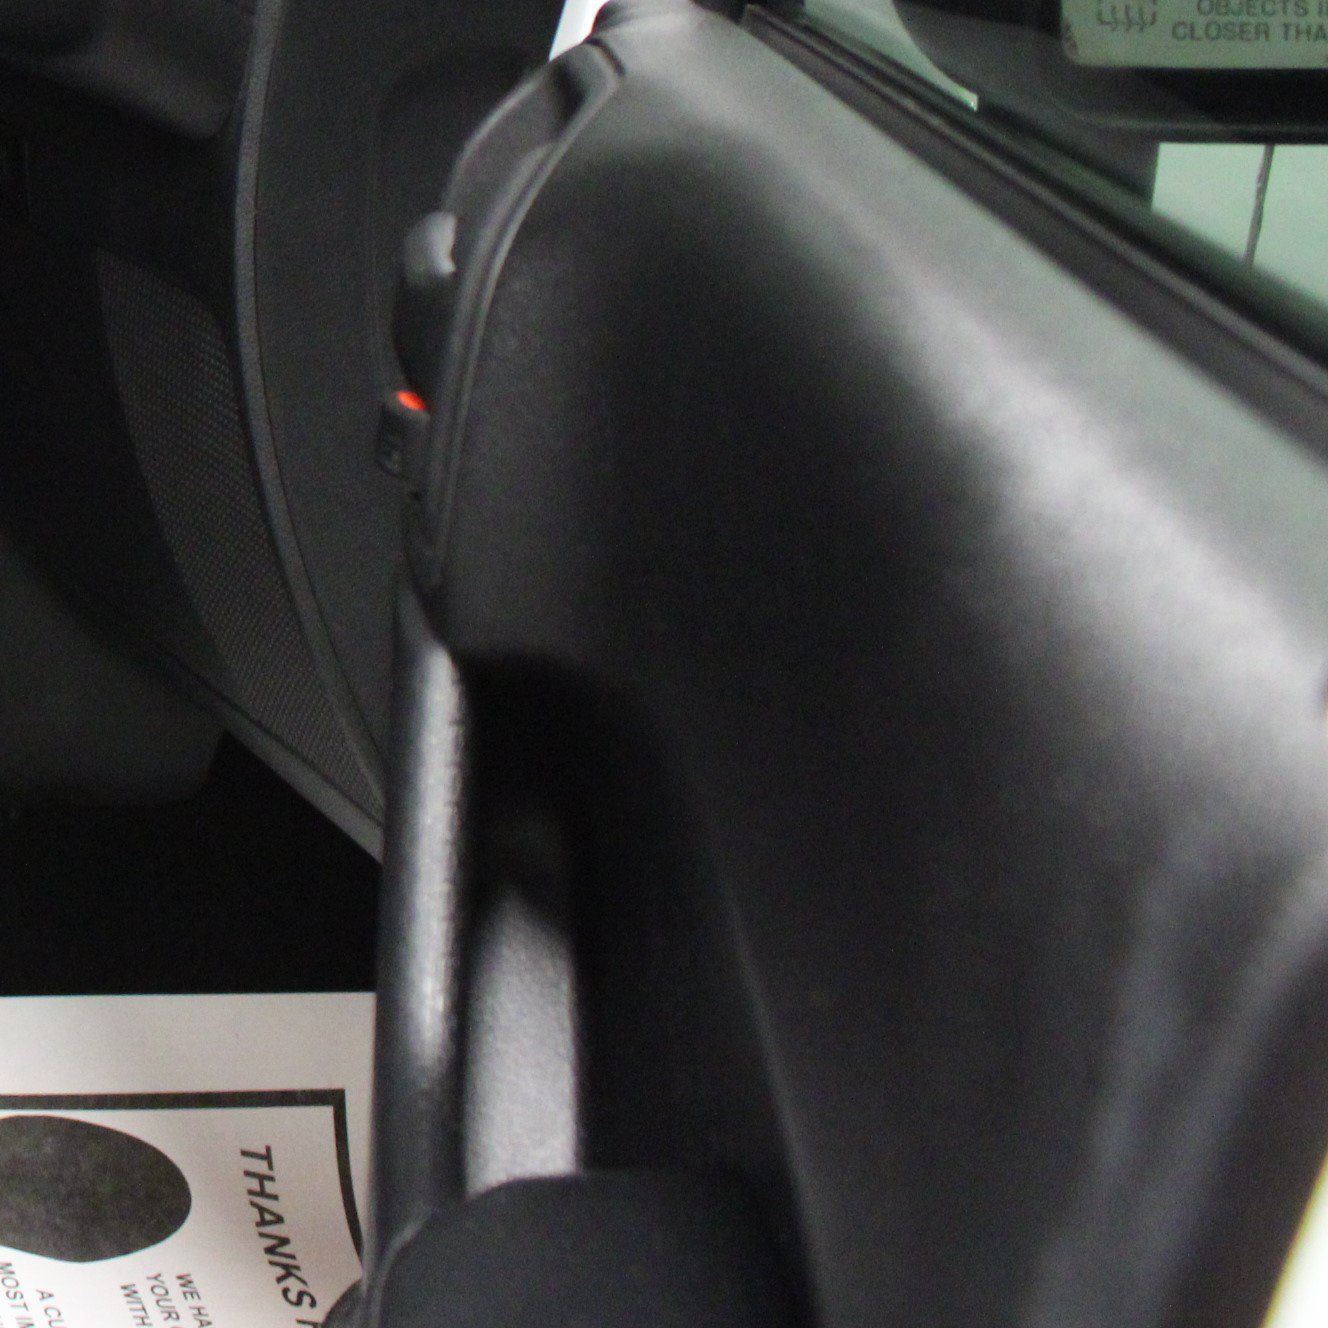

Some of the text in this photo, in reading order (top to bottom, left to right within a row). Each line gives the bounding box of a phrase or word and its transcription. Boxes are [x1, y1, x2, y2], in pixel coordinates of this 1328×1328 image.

[1171, 21, 1270, 42] CLOSER
[240, 1145, 317, 1310] THANKS
[35, 1289, 55, 1301] A
[146, 1273, 180, 1322] YOUR
[176, 1273, 201, 1300] WE
[120, 1283, 154, 1327] WITH
